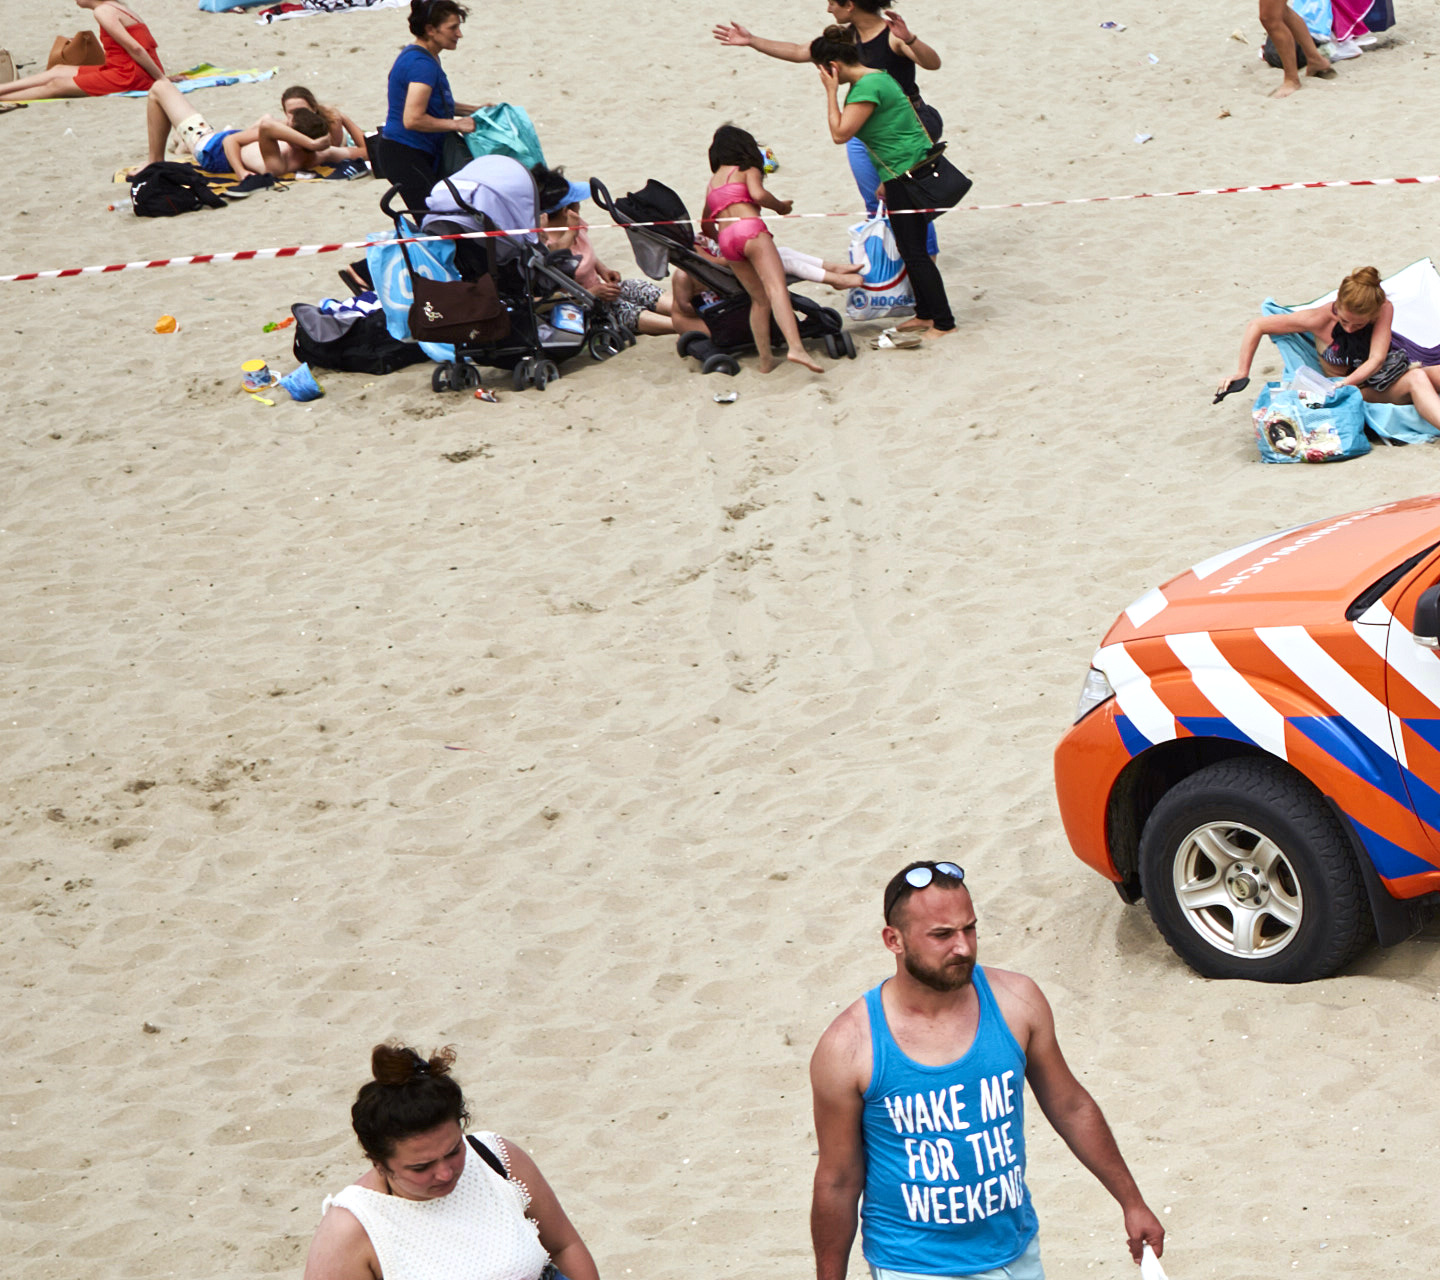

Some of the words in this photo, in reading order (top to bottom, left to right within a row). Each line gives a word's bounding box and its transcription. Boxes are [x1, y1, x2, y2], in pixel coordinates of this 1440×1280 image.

[885, 1084, 969, 1133] WAKE
[980, 1070, 1014, 1123] ME
[905, 1138, 959, 1181] FOR
[966, 1121, 1016, 1175] THE
[901, 1166, 1024, 1224] WEEKEND
